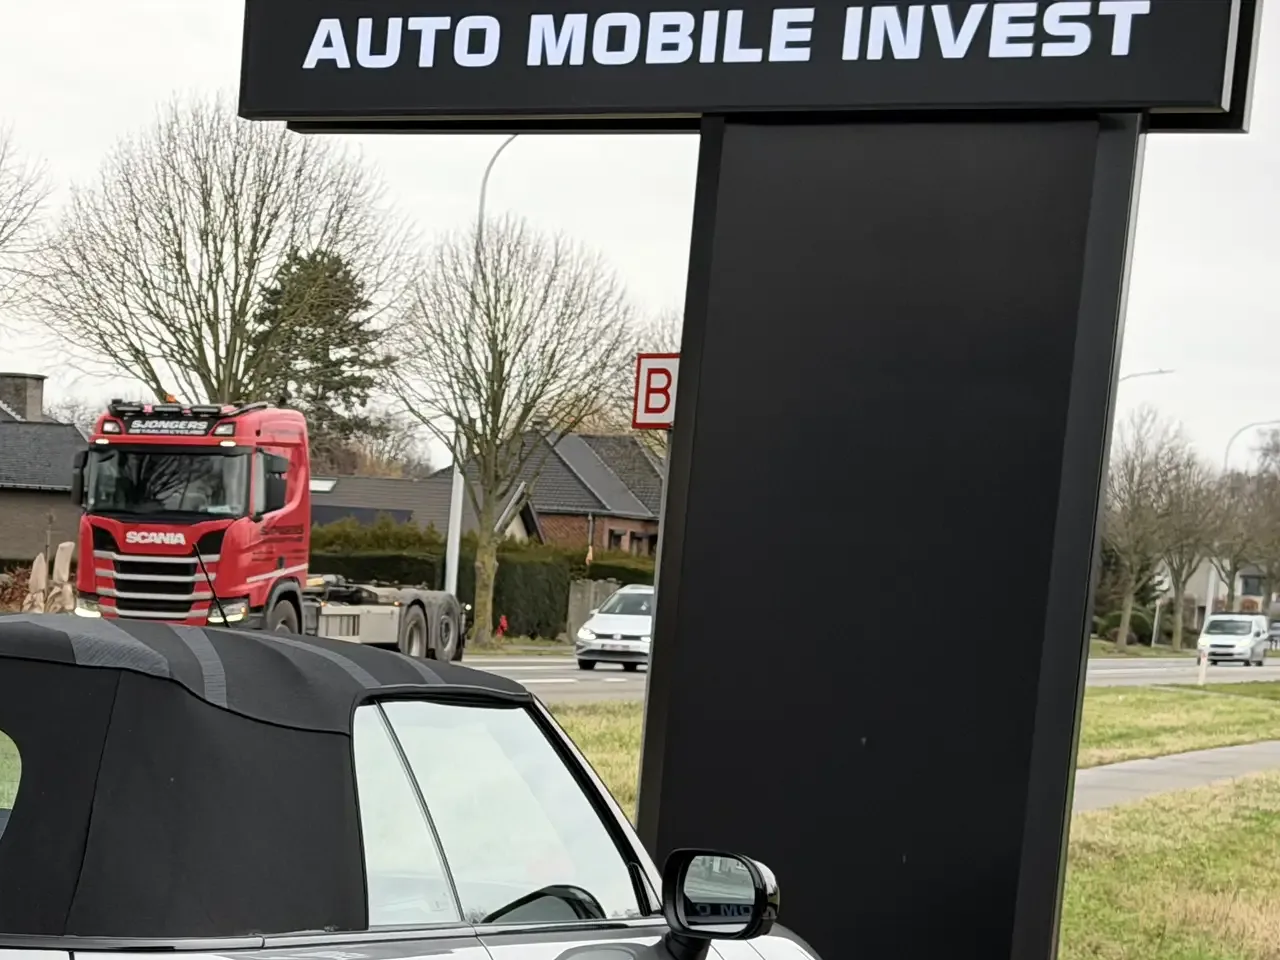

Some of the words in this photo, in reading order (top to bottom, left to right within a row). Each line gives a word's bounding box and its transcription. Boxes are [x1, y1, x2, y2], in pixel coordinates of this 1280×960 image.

[302, 15, 501, 69] AUTO
[526, 8, 816, 66] MOBILE
[841, 0, 1151, 61] INVEST
[644, 367, 673, 414] B
[125, 530, 187, 546] SCANIA
